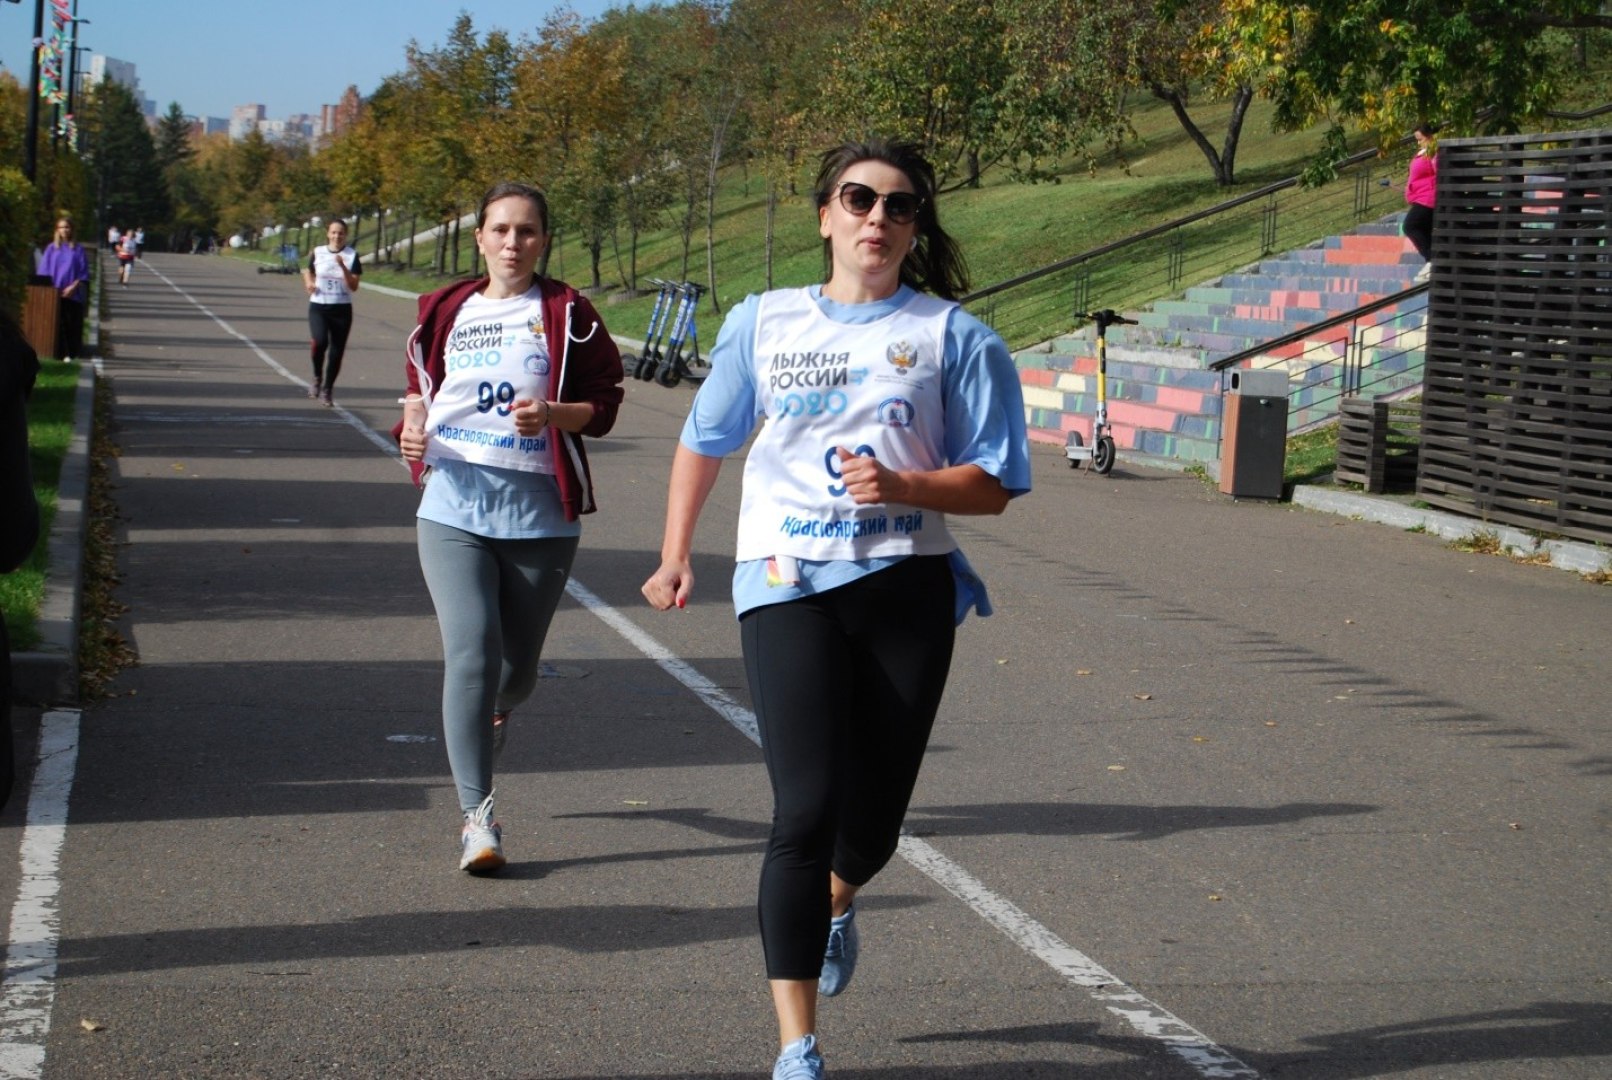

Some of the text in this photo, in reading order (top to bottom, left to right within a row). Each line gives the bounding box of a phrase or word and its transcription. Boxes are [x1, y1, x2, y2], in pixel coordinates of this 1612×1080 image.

[449, 350, 502, 372] 2020
[769, 352, 850, 373] ЛЫЖНЯ
[769, 367, 848, 393] РОССИИ
[476, 381, 515, 417] 99
[438, 424, 546, 453] Красноярский край
[825, 444, 876, 497] 9
